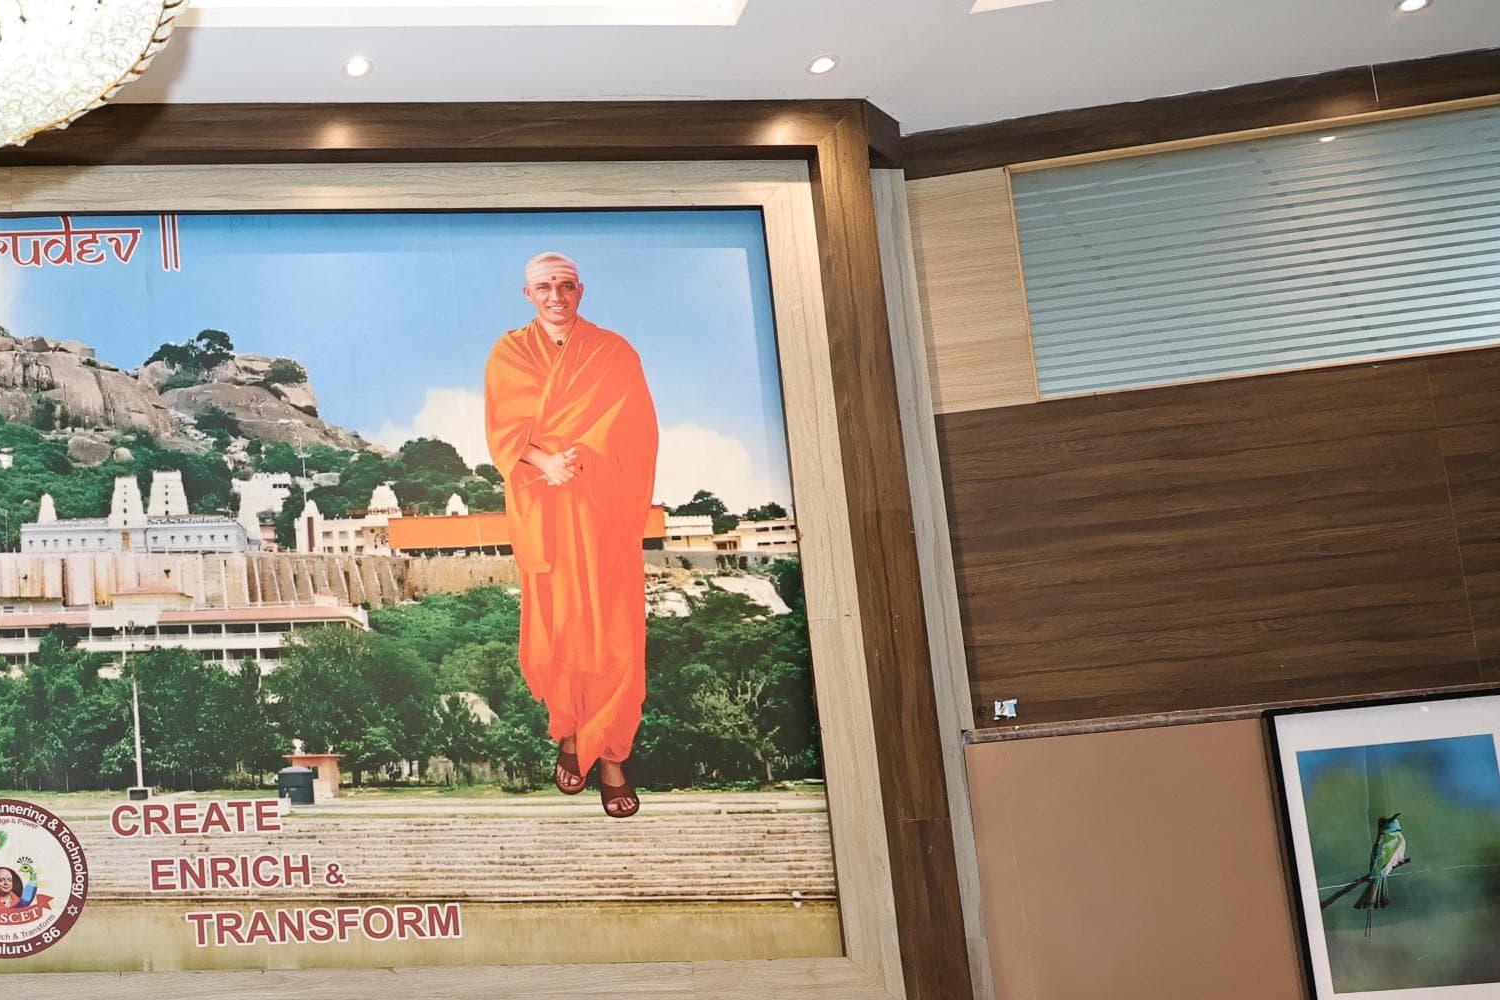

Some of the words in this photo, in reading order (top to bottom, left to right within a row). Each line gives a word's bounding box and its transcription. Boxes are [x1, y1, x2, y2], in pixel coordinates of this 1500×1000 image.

[18, 818, 39, 830] Power
[111, 800, 282, 837] CREATE
[48, 819, 58, 831] &
[57, 827, 87, 899] Technology
[151, 854, 312, 890] ENRICH
[325, 862, 346, 886] &
[13, 933, 19, 941] &
[21, 914, 56, 939] Transform
[43, 926, 61, 943] 86
[187, 903, 462, 946] TRANSFORM
